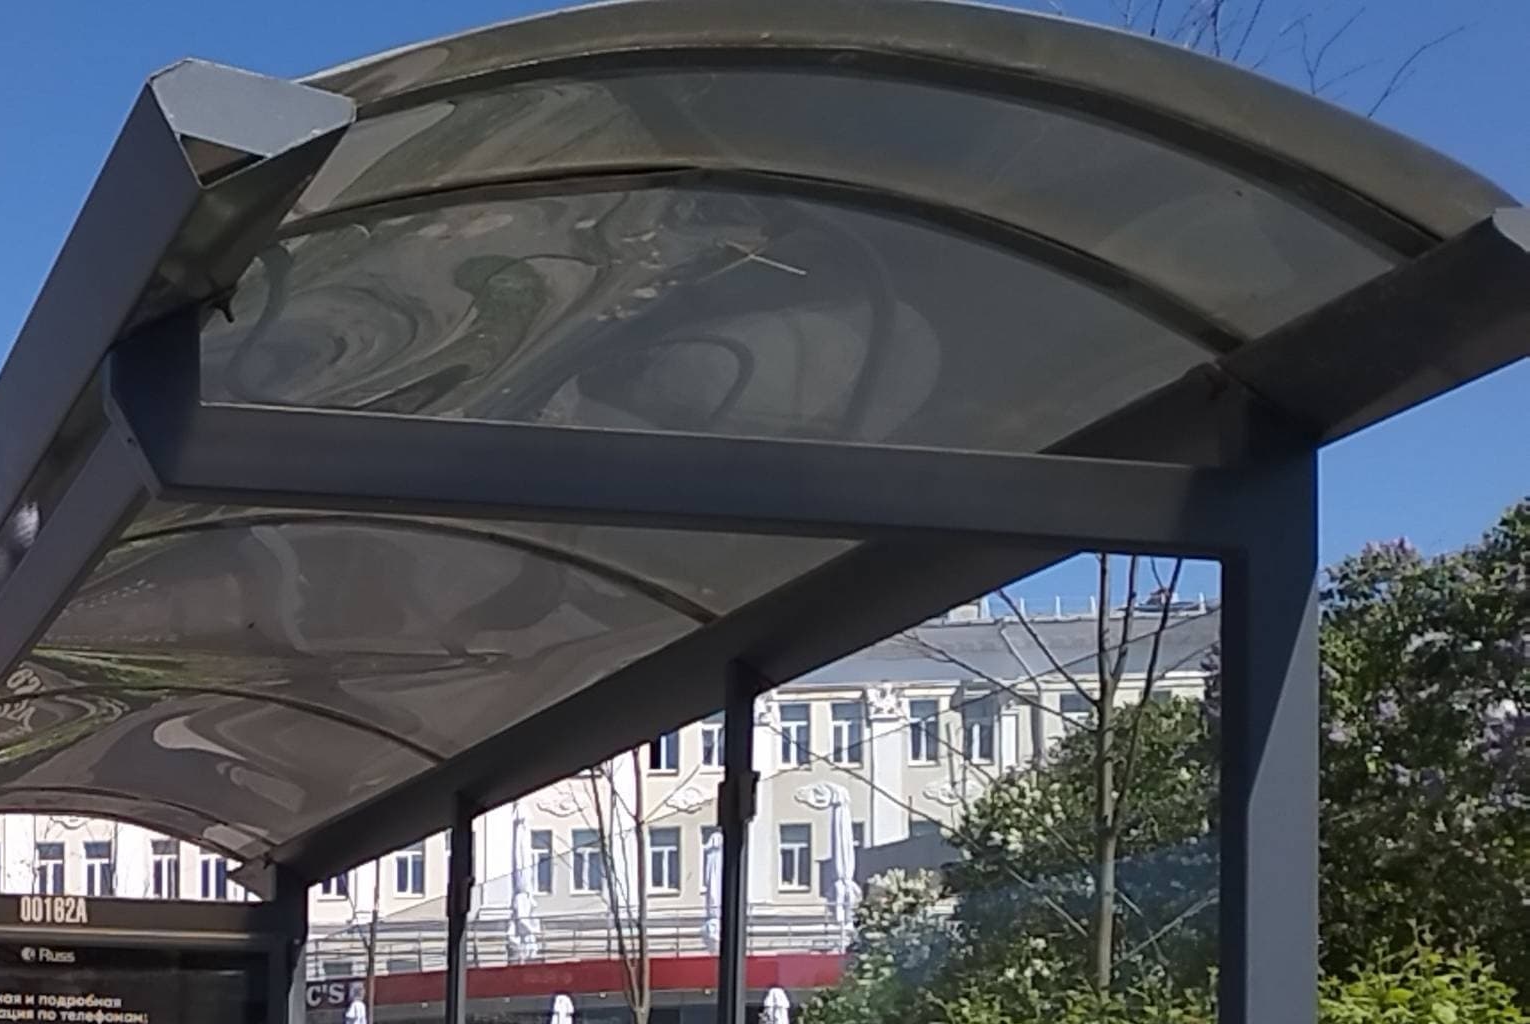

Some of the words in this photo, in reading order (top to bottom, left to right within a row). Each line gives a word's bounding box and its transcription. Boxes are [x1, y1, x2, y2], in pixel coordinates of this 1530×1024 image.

[38, 947, 75, 963] Russ
[24, 994, 35, 1005] и
[38, 993, 122, 1009] подробная
[37, 1008, 57, 1020] по
